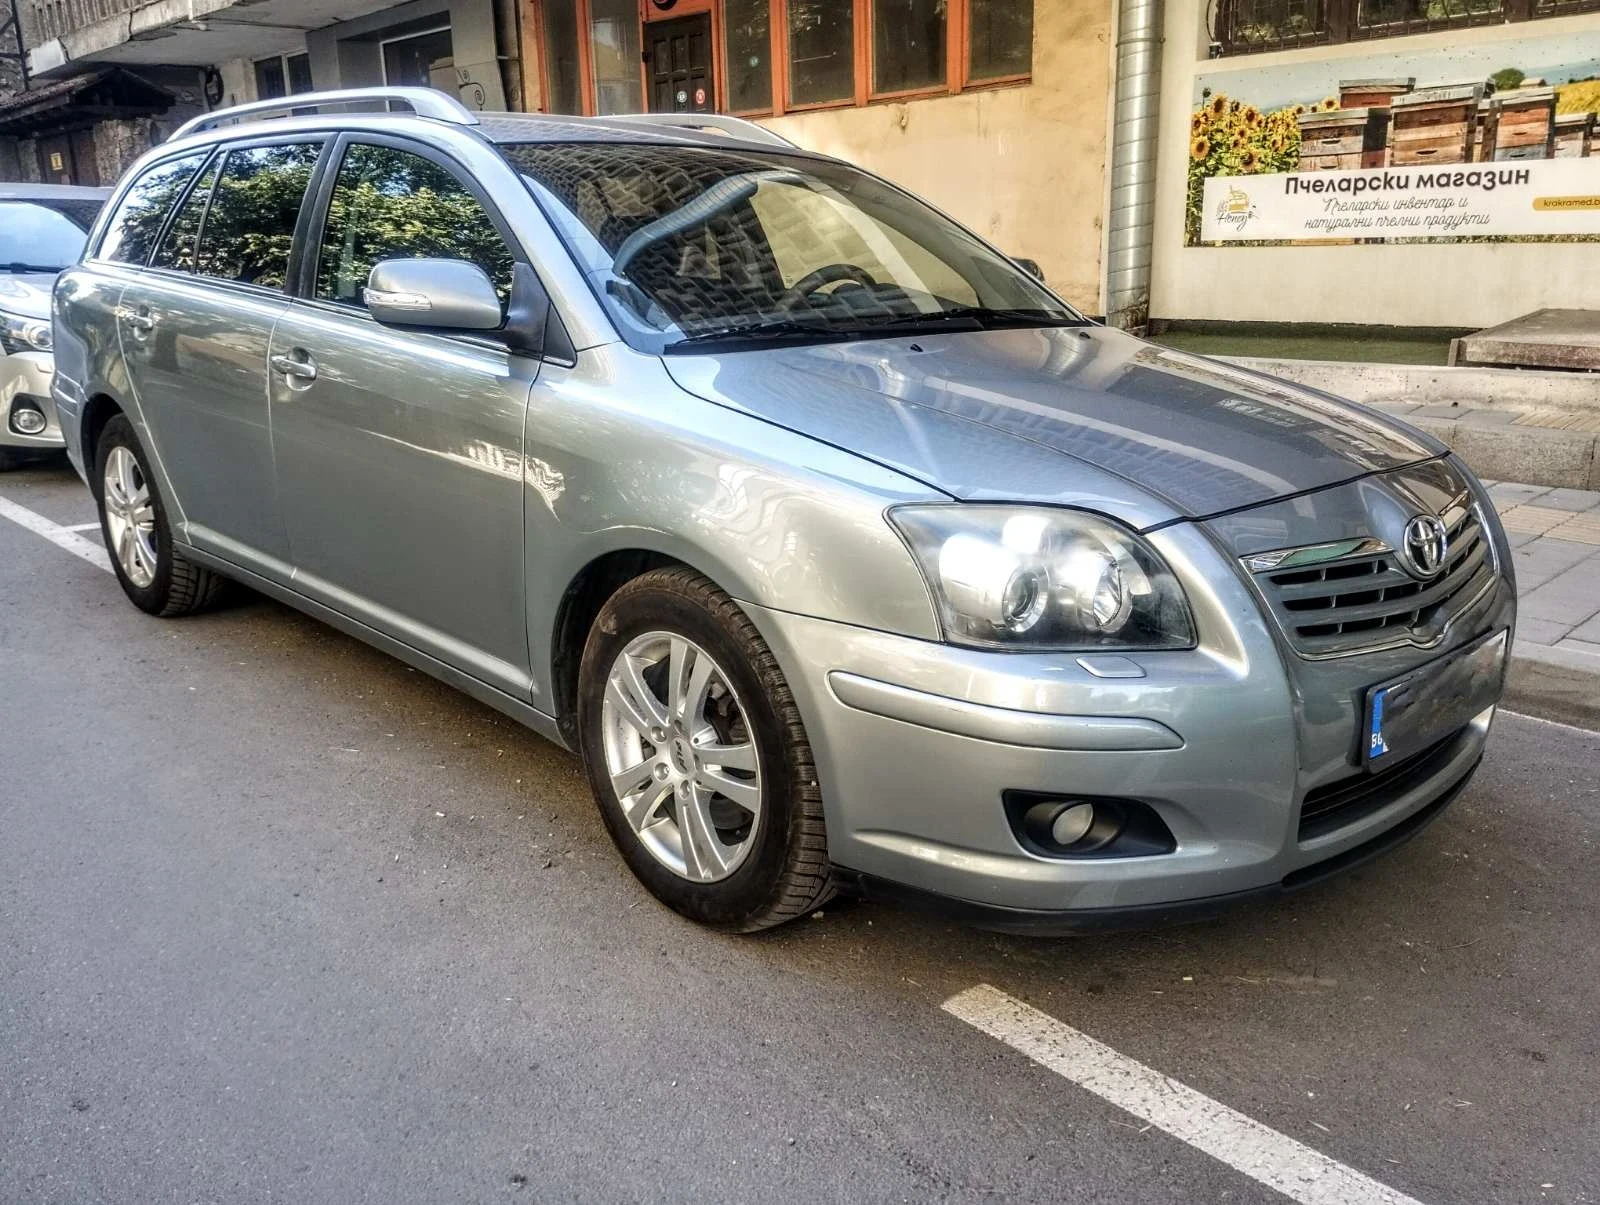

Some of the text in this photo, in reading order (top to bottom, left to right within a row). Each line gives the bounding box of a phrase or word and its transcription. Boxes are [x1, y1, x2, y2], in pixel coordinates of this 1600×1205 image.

[1285, 168, 1530, 196] Пчеларски магазин
[1322, 196, 1468, 215] Пчеларски инвентар и
[1304, 212, 1491, 233] натурални пчелни продукти
